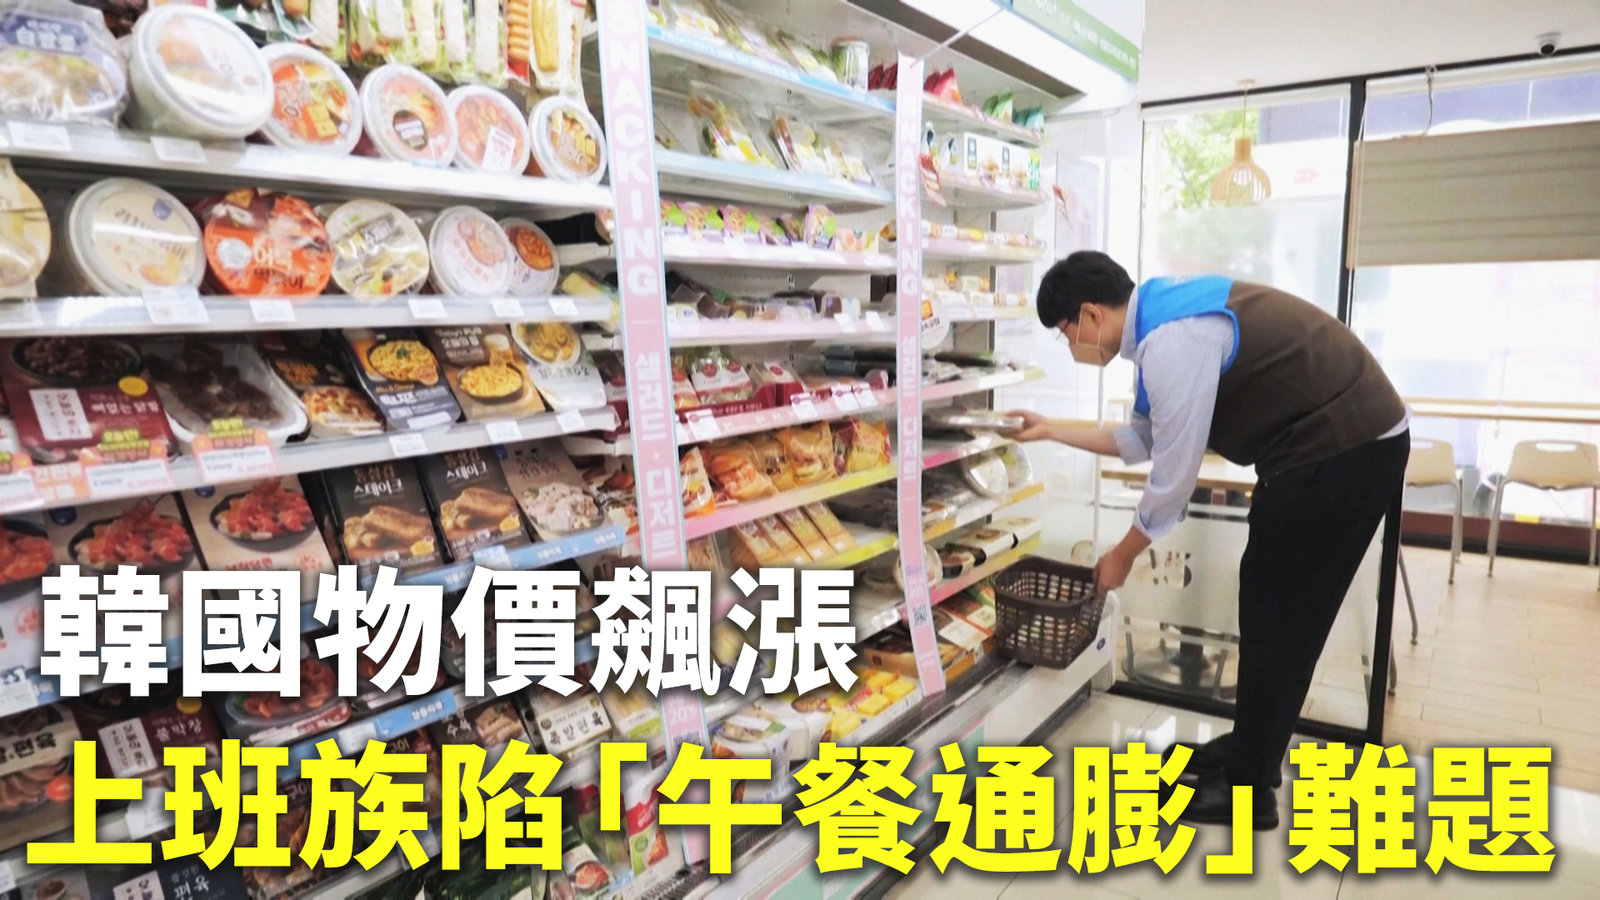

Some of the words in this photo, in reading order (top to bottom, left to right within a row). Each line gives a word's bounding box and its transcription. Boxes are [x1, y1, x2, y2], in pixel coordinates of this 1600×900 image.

[606, 1, 663, 297] SNACKING
[900, 95, 919, 297] SNACKING
[353, 478, 404, 497] 스테이크
[446, 461, 488, 480] 스테이크
